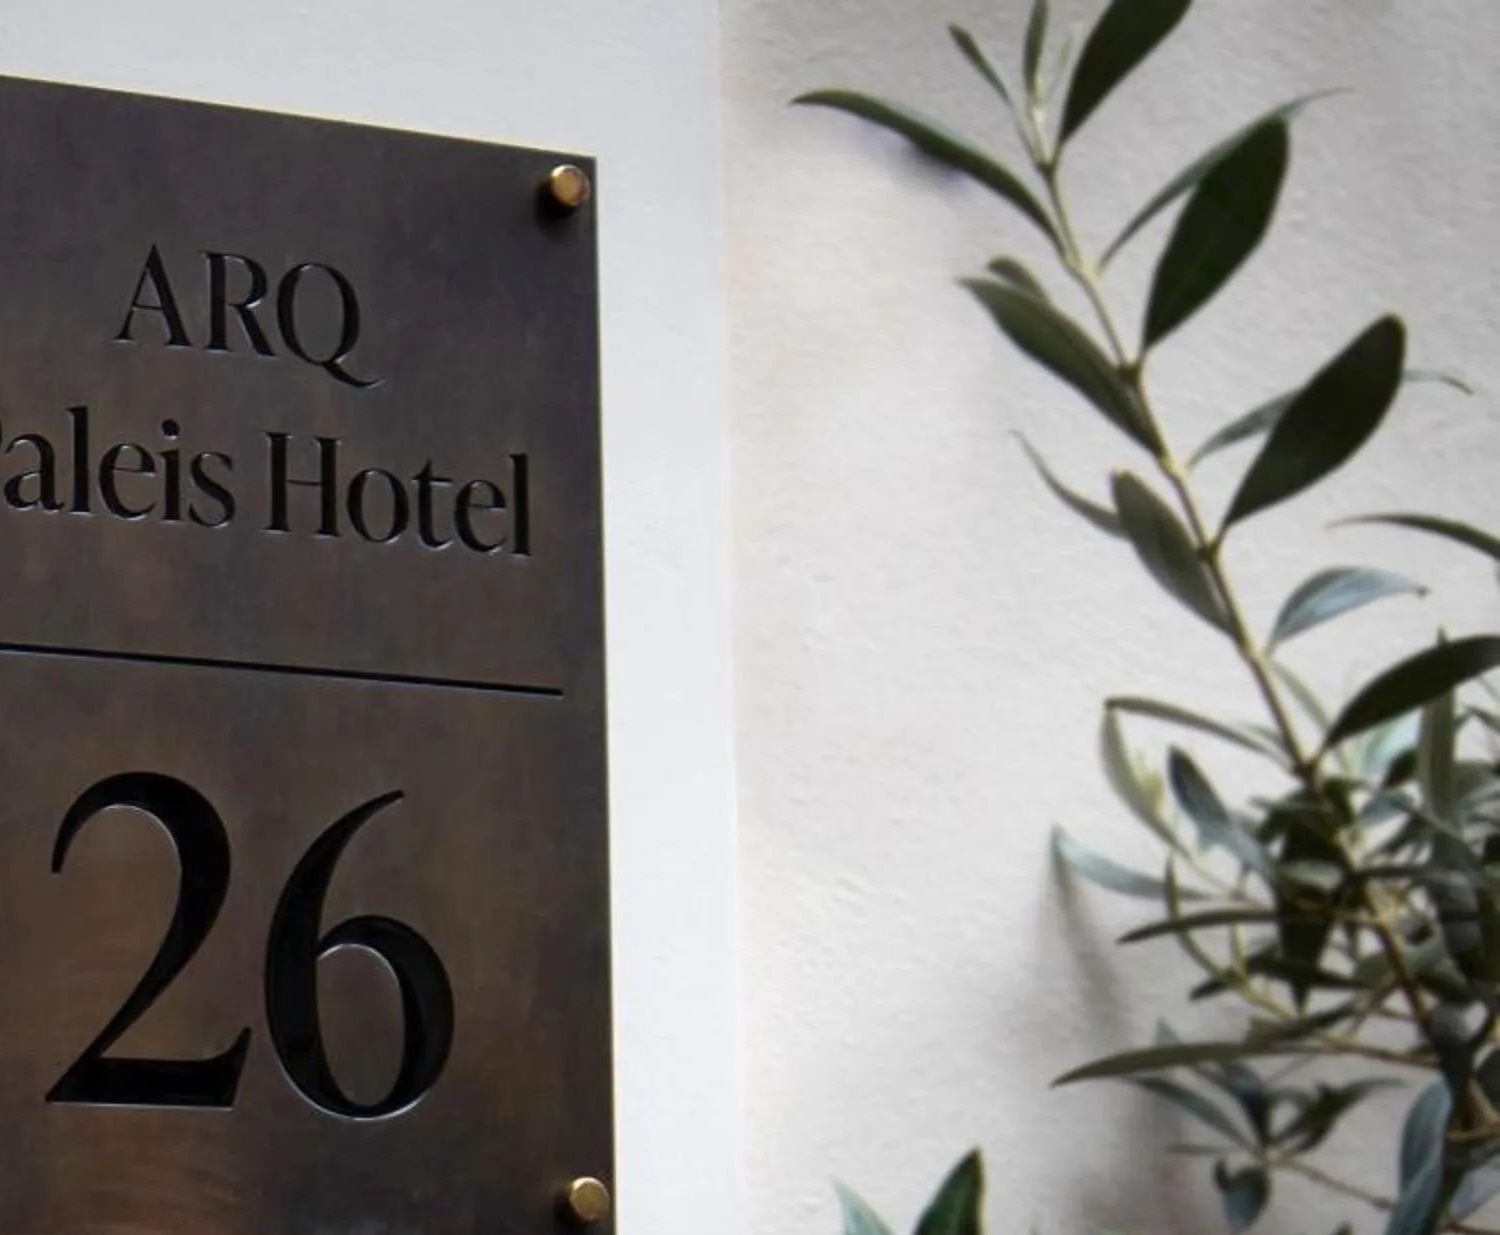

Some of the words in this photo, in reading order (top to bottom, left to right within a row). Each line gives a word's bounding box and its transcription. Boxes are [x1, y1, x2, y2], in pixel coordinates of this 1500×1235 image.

[115, 243, 386, 388] ARQ
[262, 431, 533, 557] Hotel
[46, 771, 454, 1121] 26
